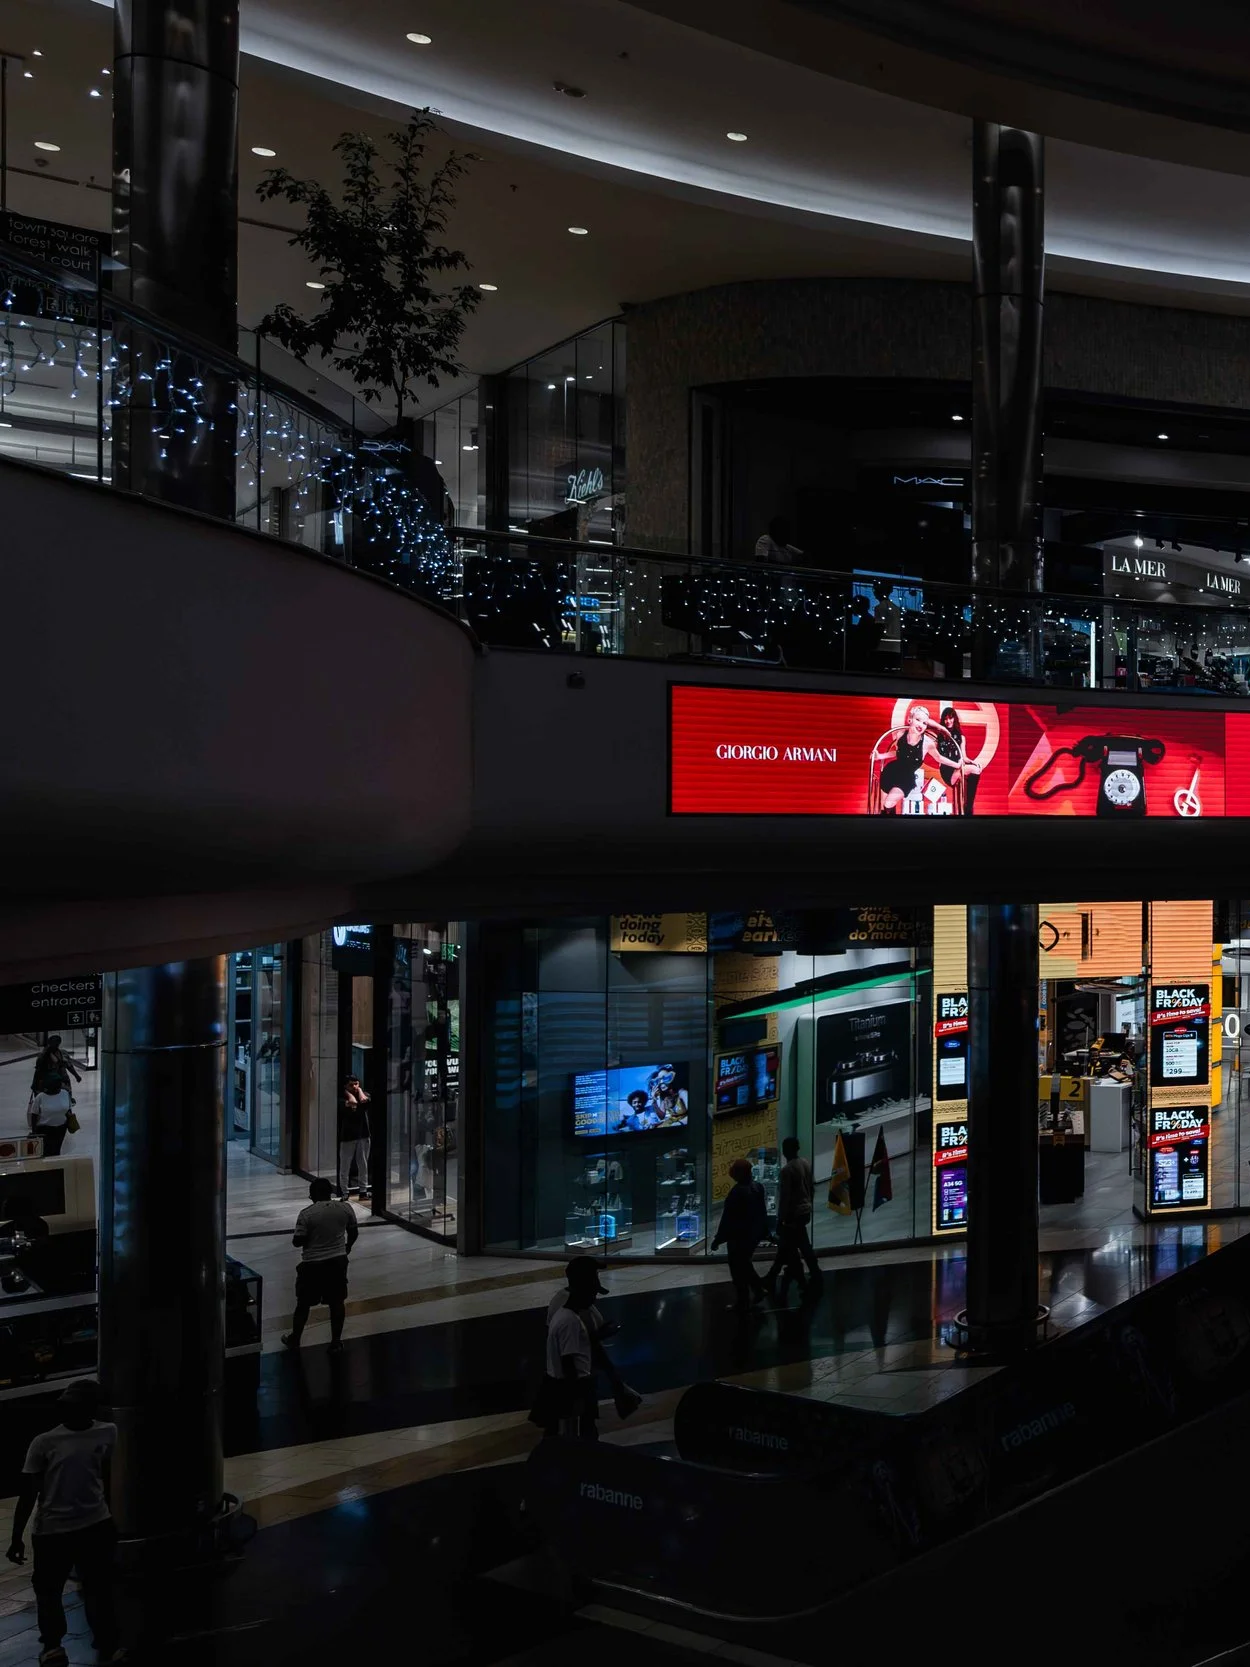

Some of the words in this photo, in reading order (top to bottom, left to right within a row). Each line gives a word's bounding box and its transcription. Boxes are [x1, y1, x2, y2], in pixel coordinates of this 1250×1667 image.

[8, 217, 46, 236] town
[51, 228, 99, 246] square
[8, 231, 51, 249] forest
[56, 242, 92, 257] walk
[1111, 555, 1129, 573] LA
[1134, 558, 1167, 578] MER
[1206, 572, 1220, 588] LA
[1221, 575, 1242, 595] MER
[716, 743, 778, 762] GIORGIO
[783, 746, 838, 763] ARMANI
[619, 918, 662, 933] doing
[622, 931, 665, 946] today
[848, 928, 868, 941] do
[870, 931, 909, 941] more
[31, 980, 95, 994] checkers
[1155, 989, 1196, 999] BLACK
[31, 995, 97, 1008] entrance
[941, 996, 968, 1008] BLA
[1068, 1081, 1081, 1097] 2
[1154, 1110, 1195, 1121] BLACK
[941, 1125, 968, 1137] BLA
[1000, 1400, 1077, 1453] rabanne
[727, 1424, 789, 1451] rabanne
[579, 1480, 644, 1511] rabanne
